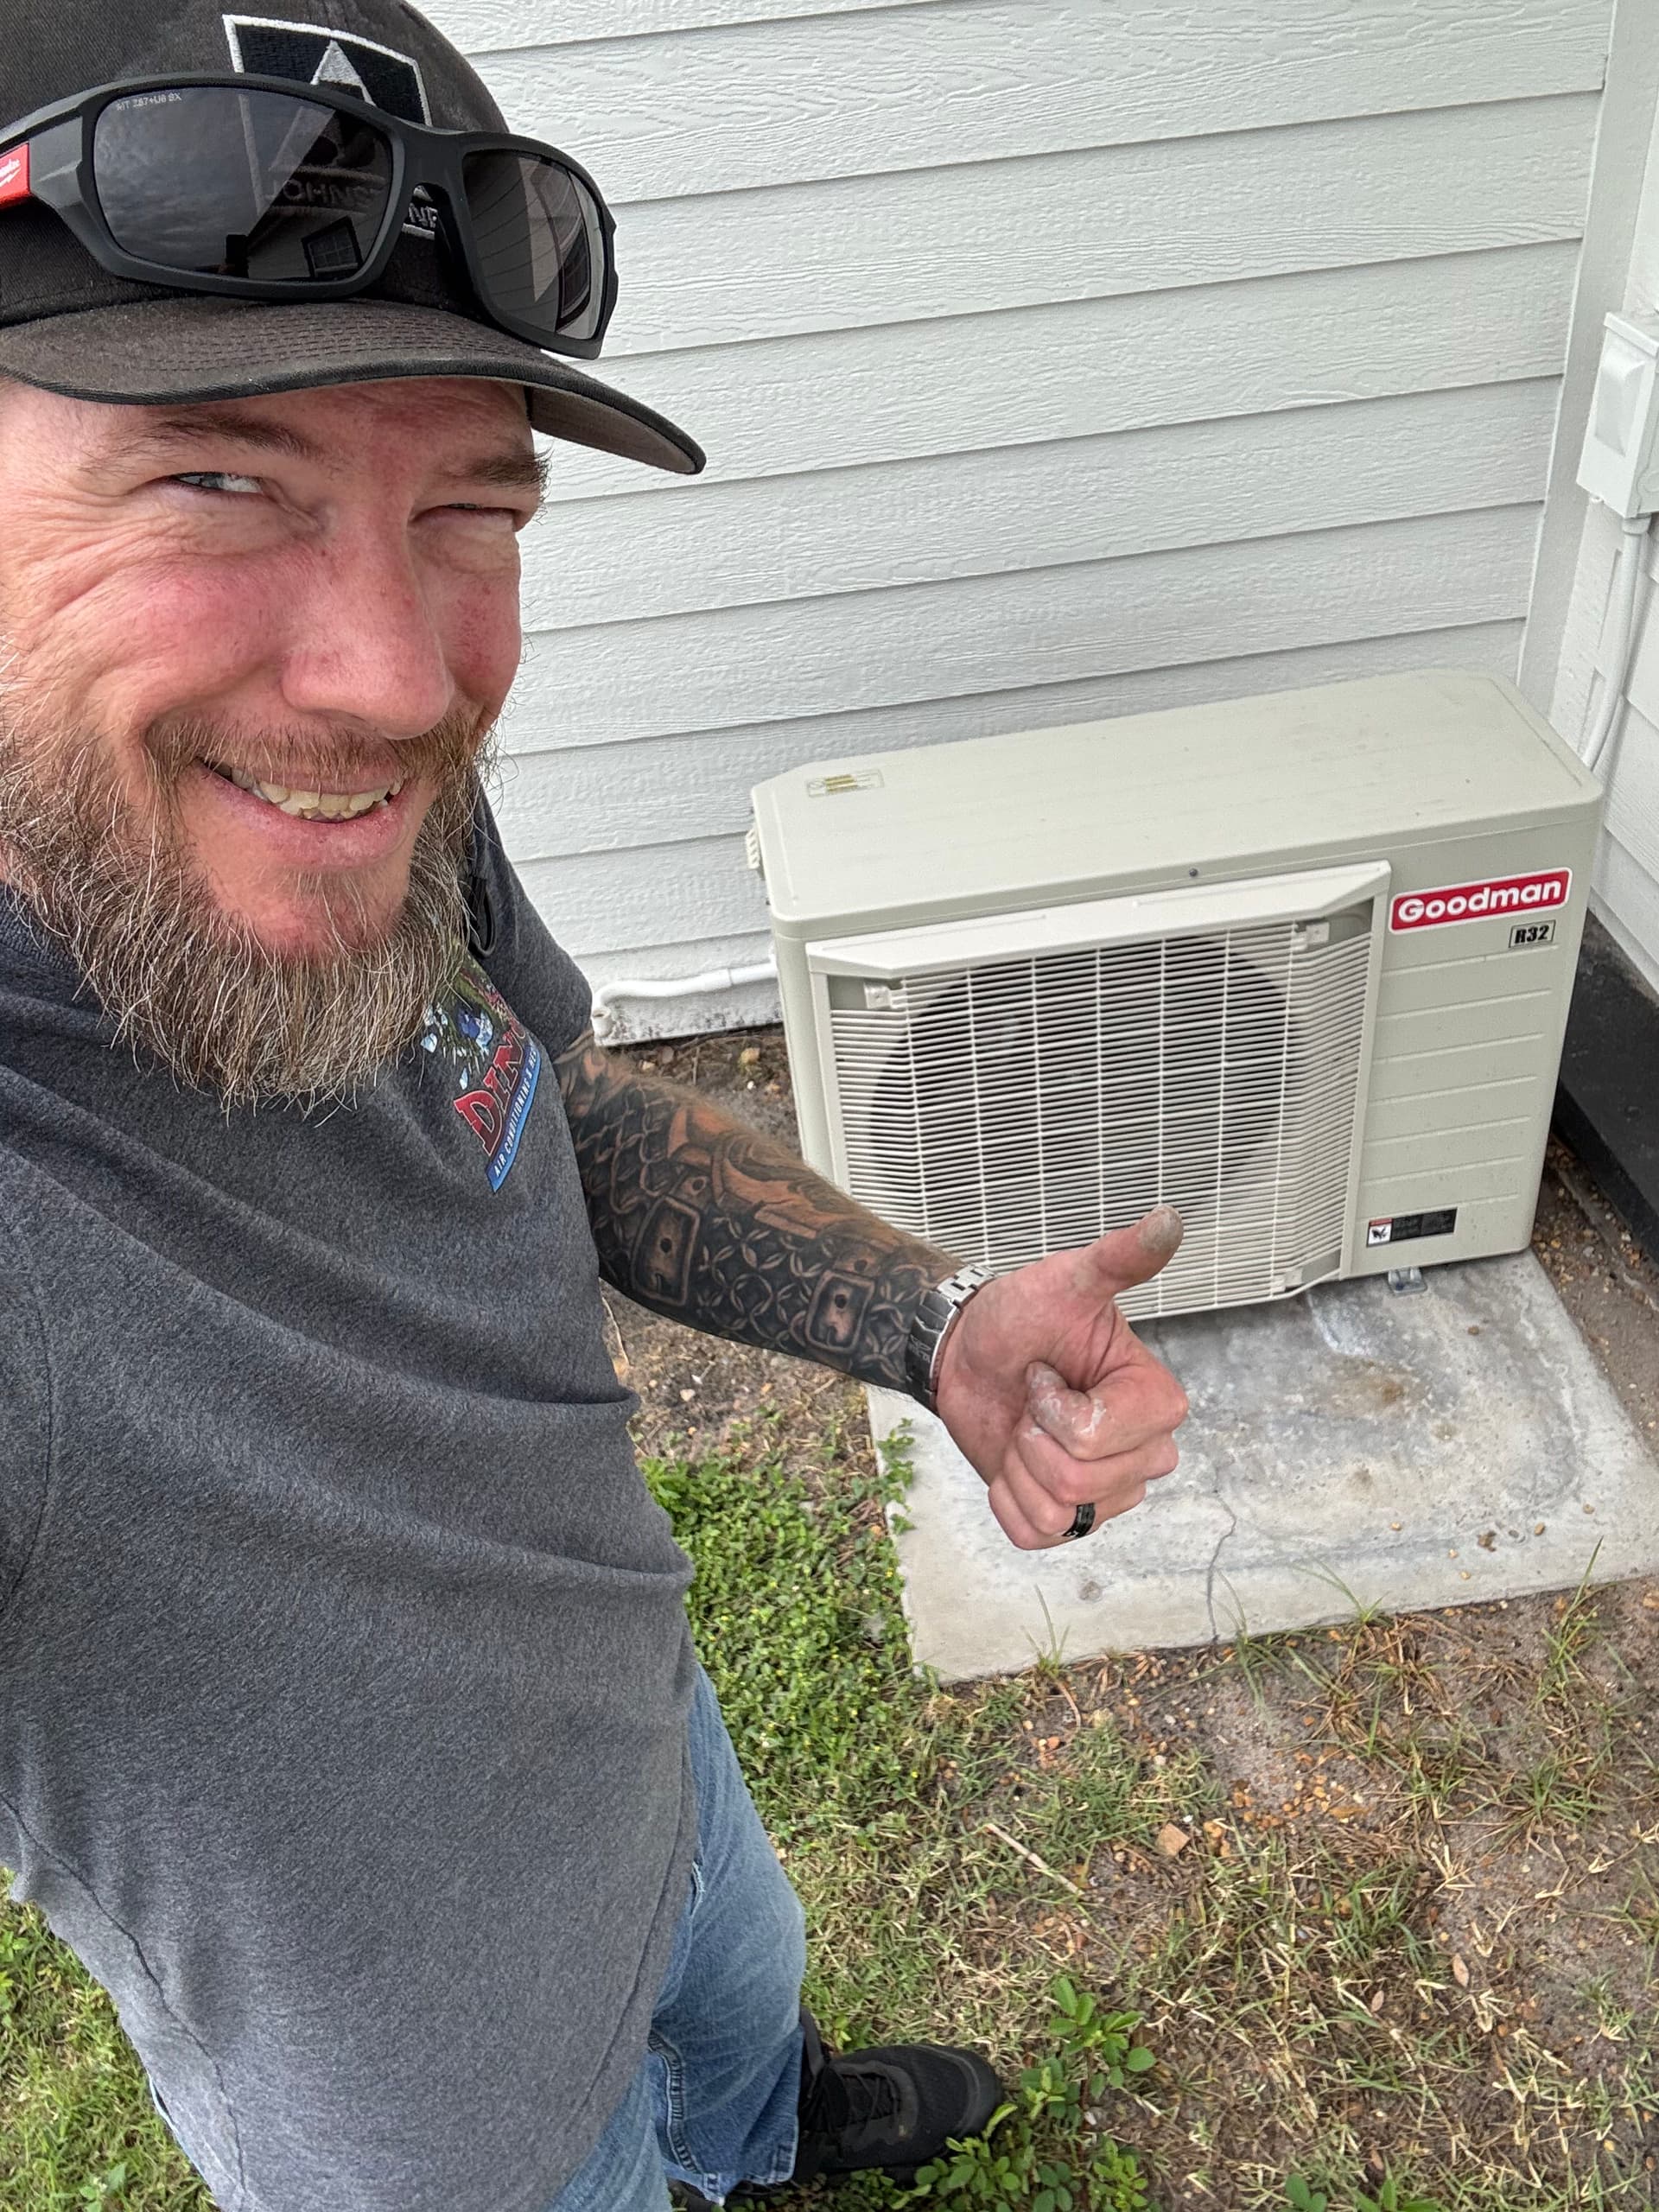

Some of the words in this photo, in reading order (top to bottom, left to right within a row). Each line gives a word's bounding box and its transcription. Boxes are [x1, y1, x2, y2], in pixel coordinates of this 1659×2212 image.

[1398, 880, 1562, 923] Goodman
[1514, 925, 1549, 945] R32
[494, 1154, 507, 1178] AIR
[504, 1079, 531, 1154] CONDITIONING
